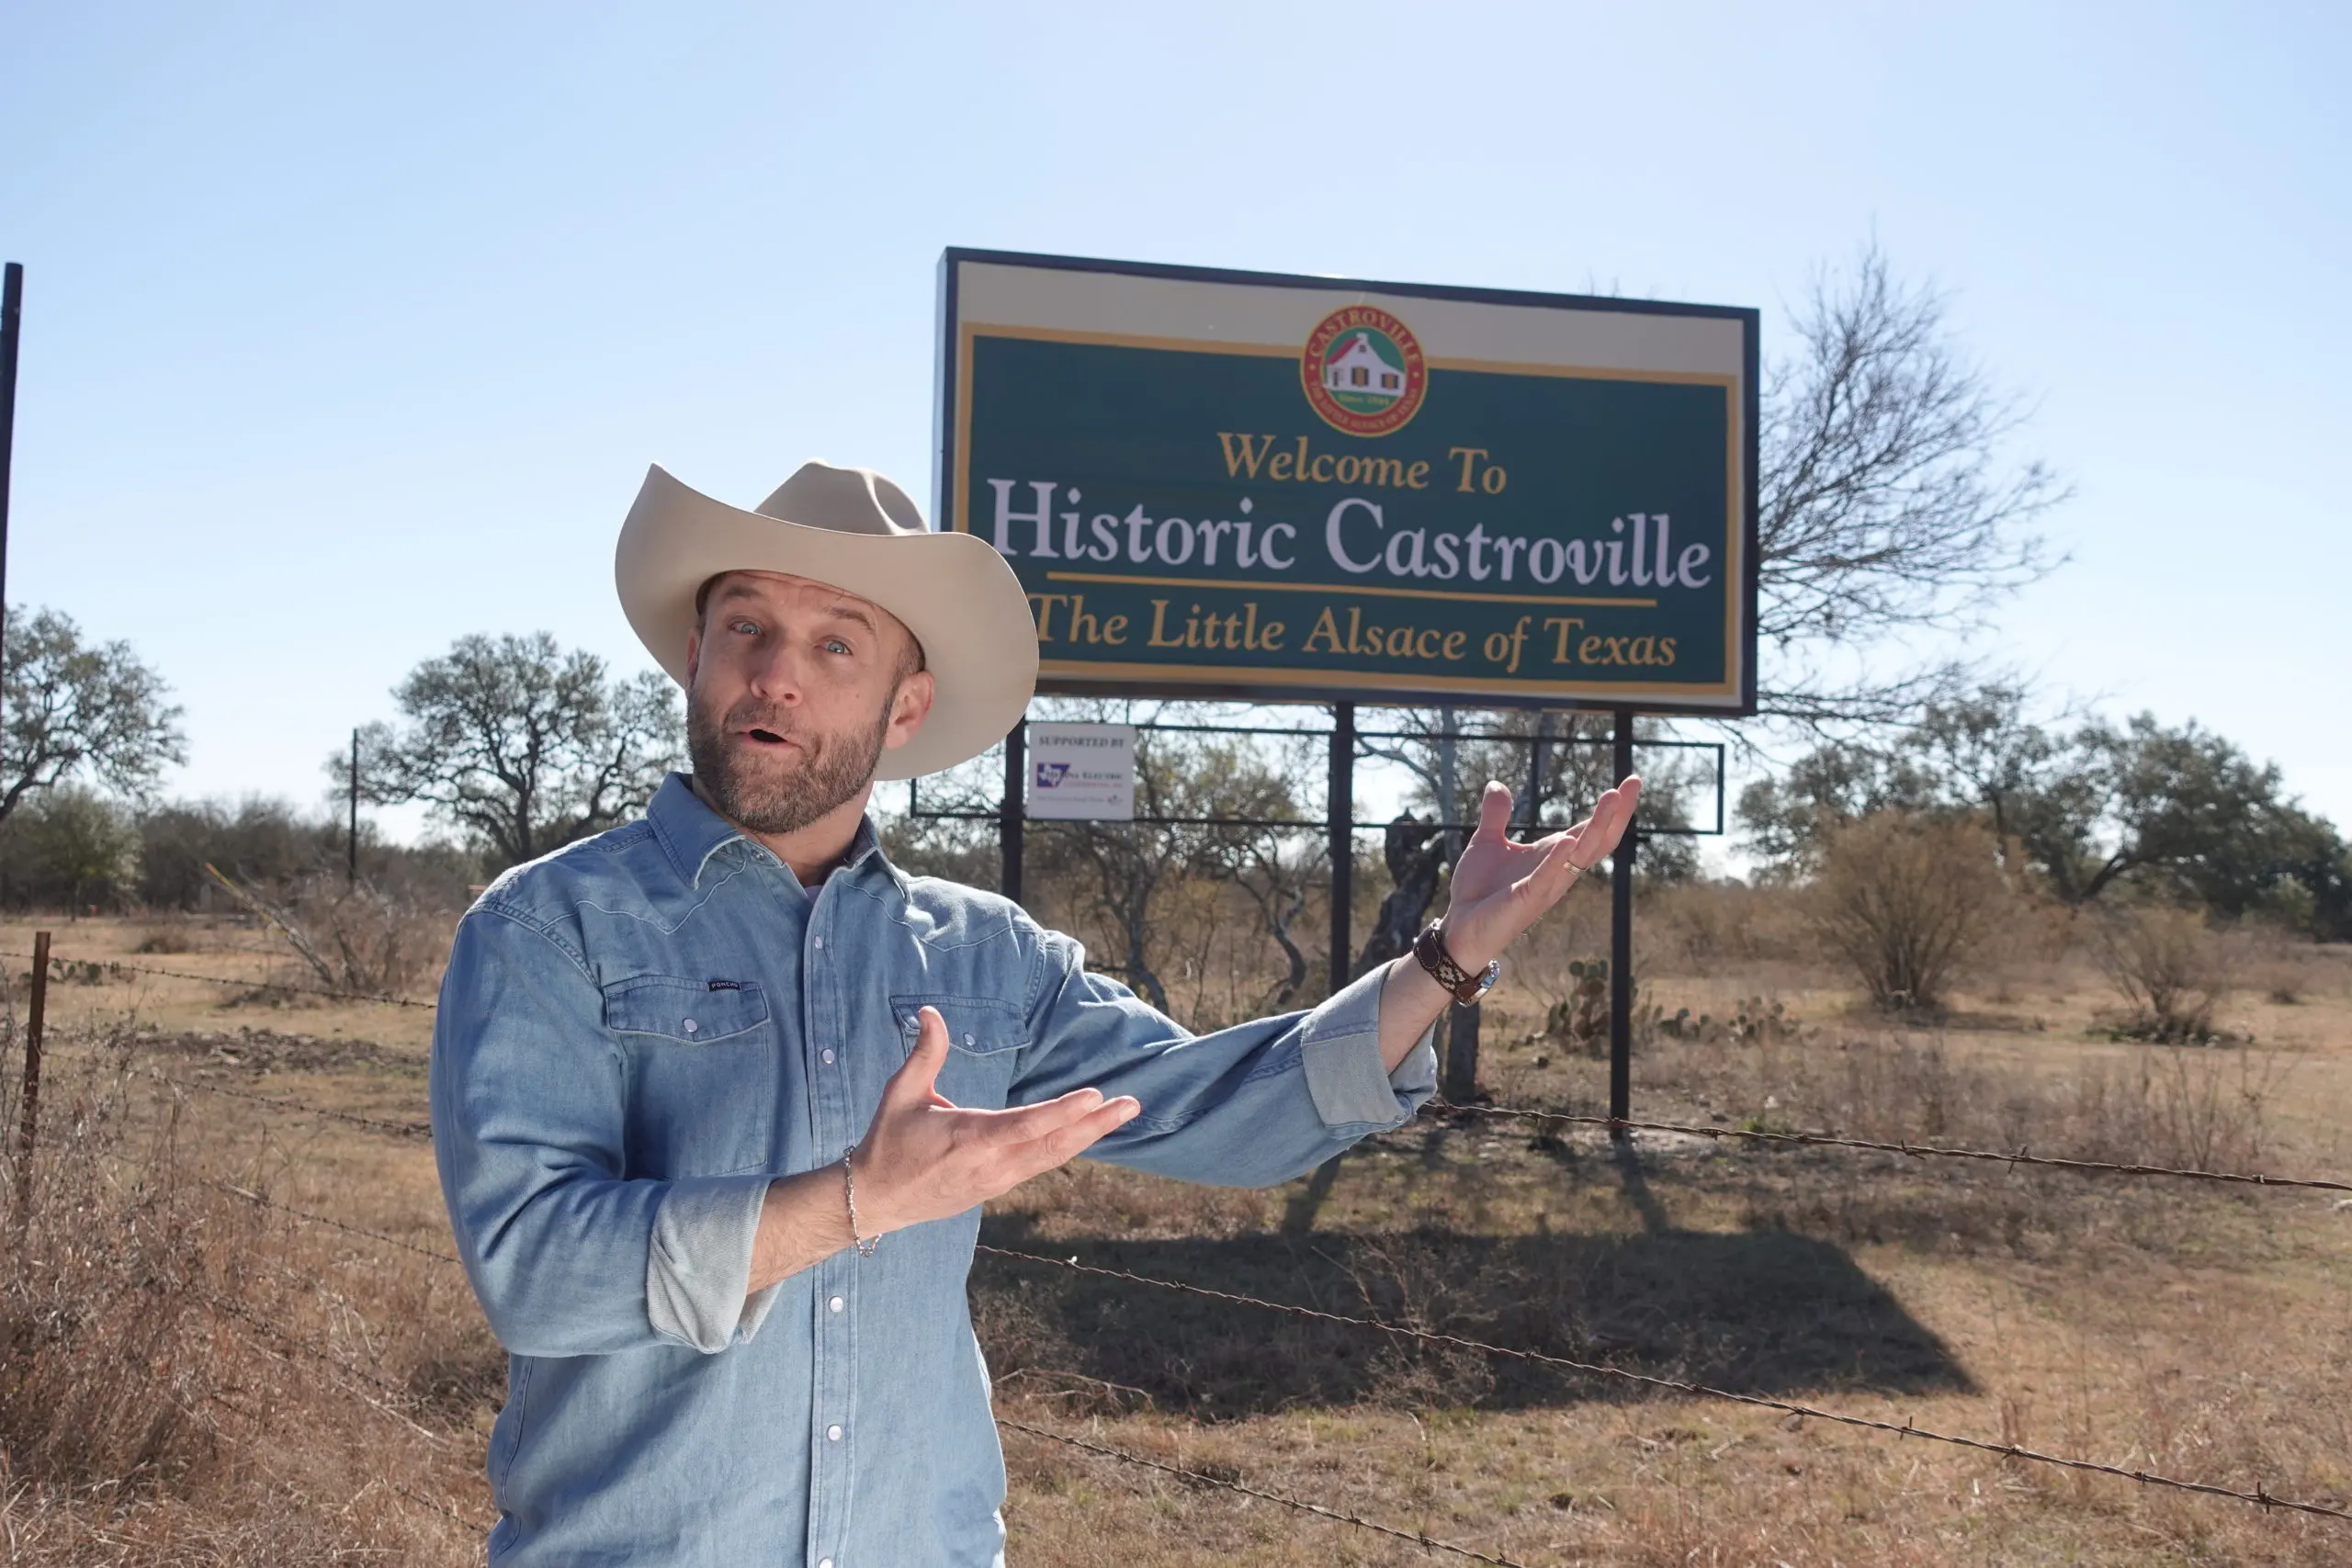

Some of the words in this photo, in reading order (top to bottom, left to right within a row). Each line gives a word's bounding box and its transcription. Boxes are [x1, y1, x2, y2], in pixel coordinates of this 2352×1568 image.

[1308, 310, 1419, 362] CASTROVILLE
[1216, 432, 1430, 491] Welcome
[1449, 446, 1507, 494] To
[987, 478, 1296, 570] Historic
[1325, 497, 1712, 588] Castroville
[1027, 592, 1128, 645] The
[1148, 599, 1286, 651] Little
[1302, 605, 1466, 660] Alsace
[1484, 615, 1532, 673] of
[1544, 617, 1677, 666] Texas
[1039, 736, 1109, 748] SUPPORTED
[1111, 738, 1125, 749] BY
